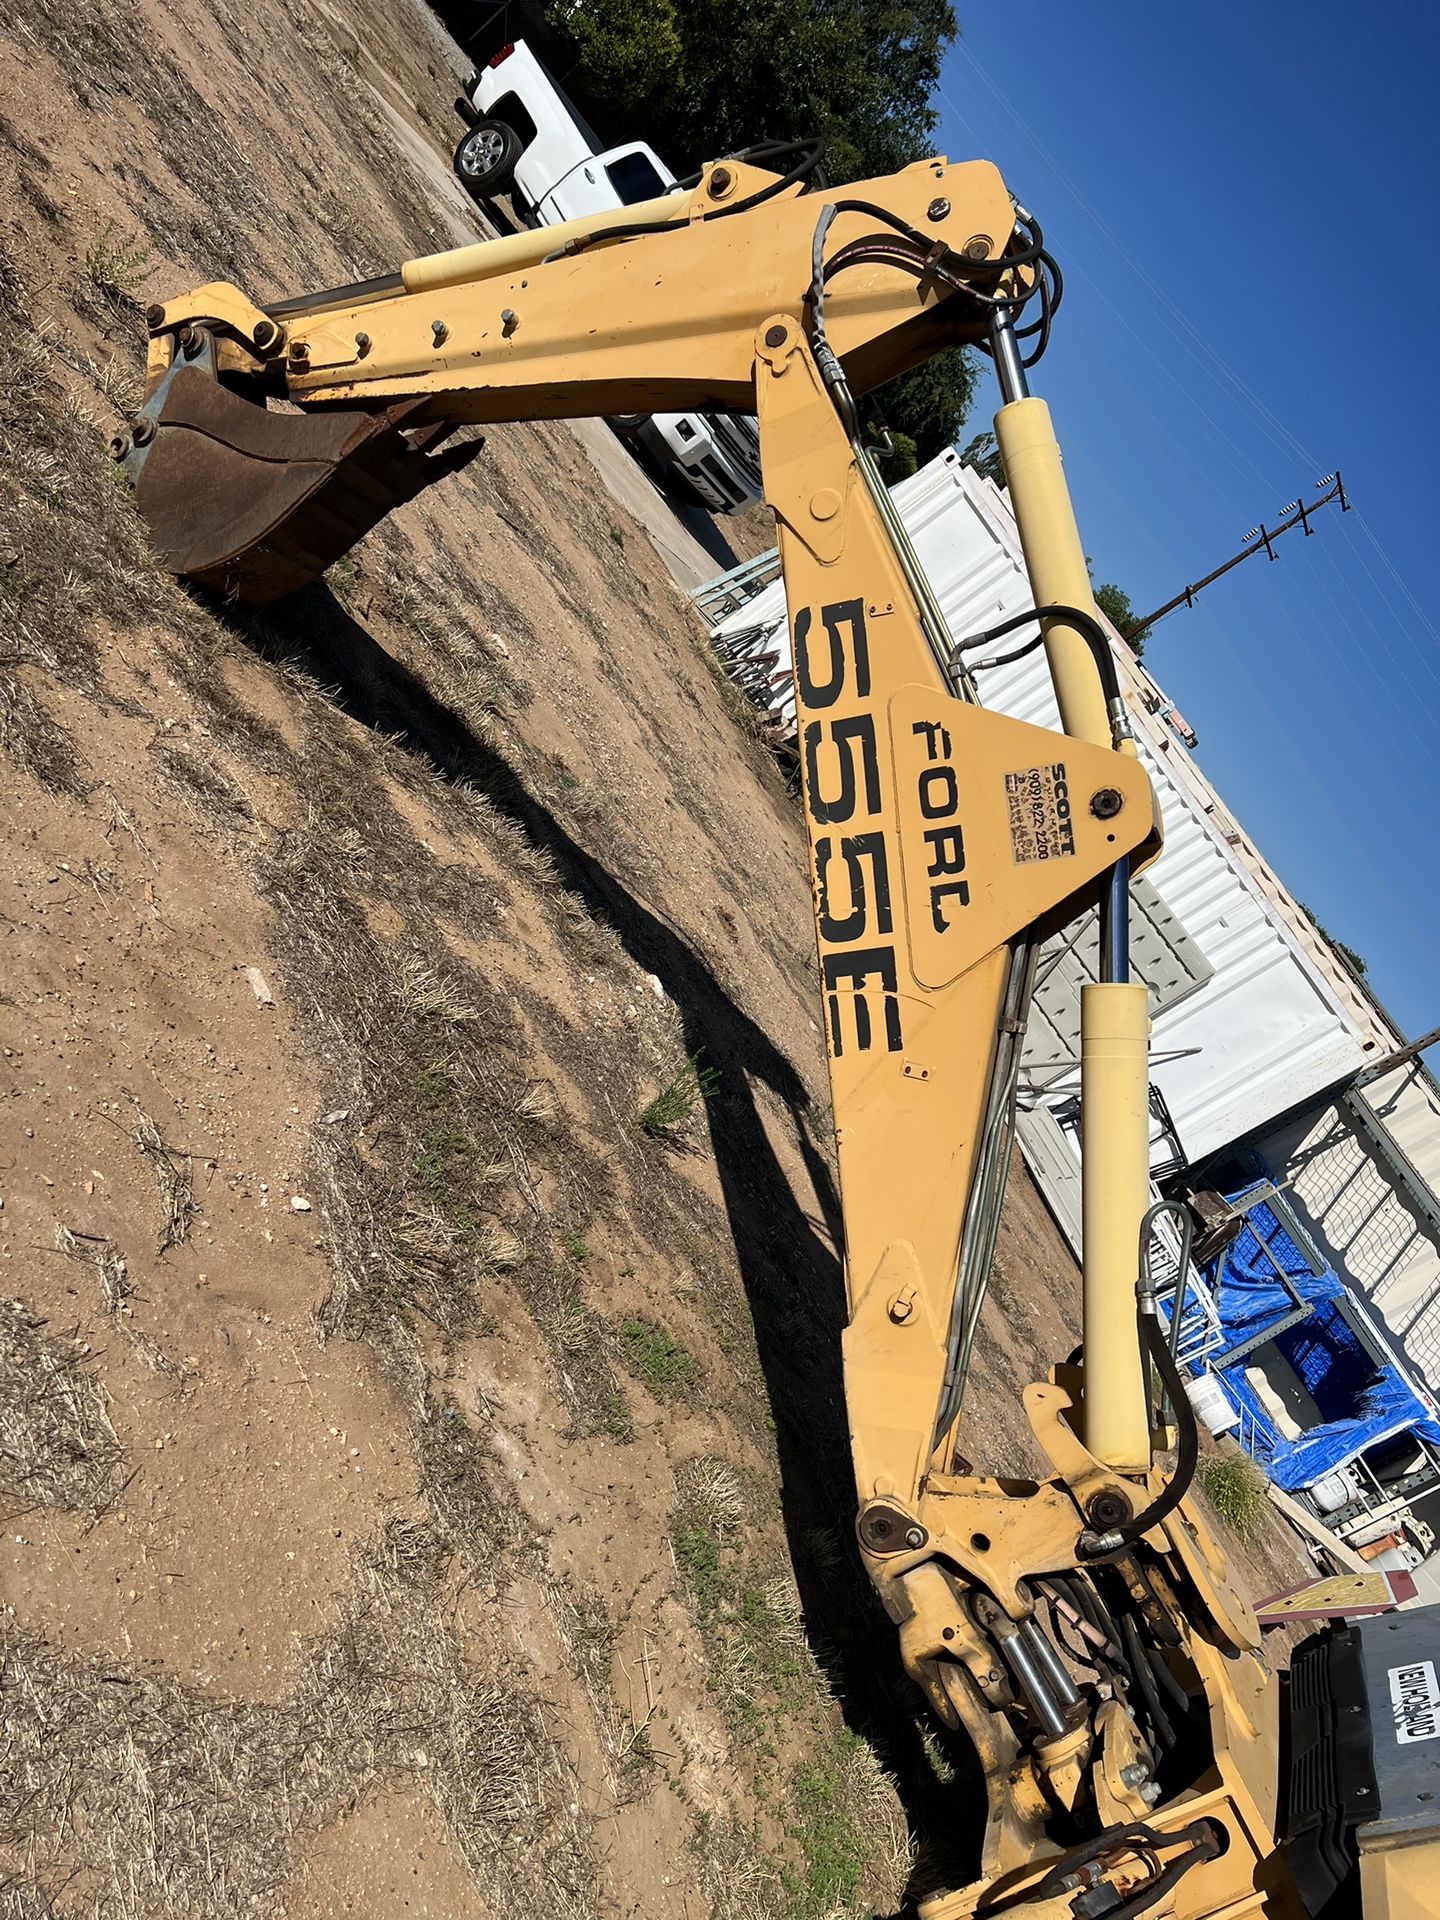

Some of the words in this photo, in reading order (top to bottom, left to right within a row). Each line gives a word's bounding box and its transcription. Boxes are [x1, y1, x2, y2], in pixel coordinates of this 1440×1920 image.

[794, 597, 903, 1058] 555E
[1051, 763, 1075, 856] SCOTT
[1397, 1666, 1427, 1688] NEW
